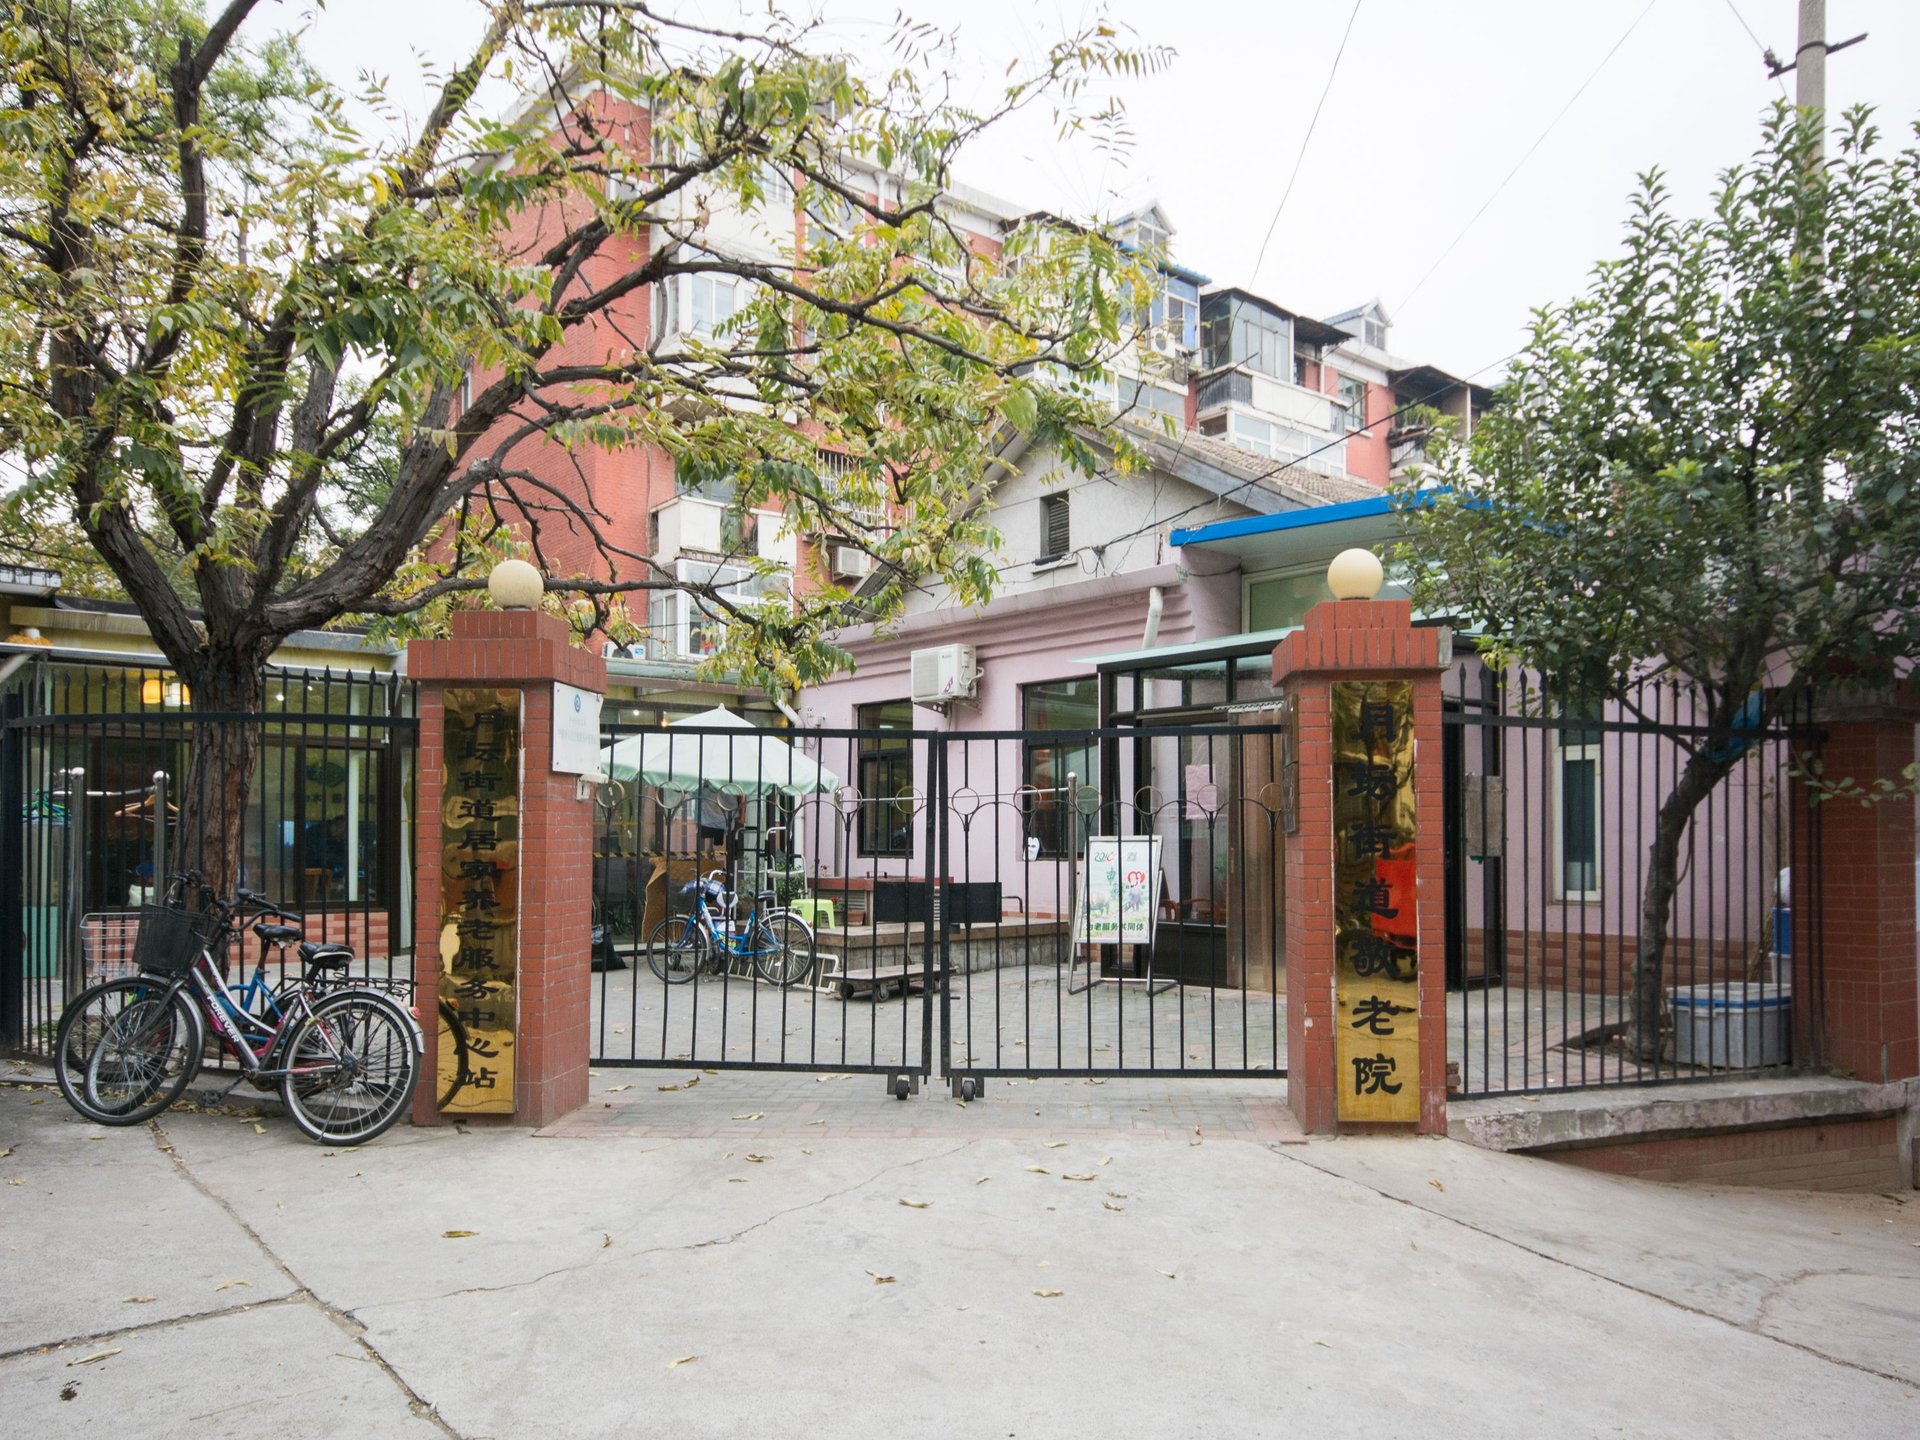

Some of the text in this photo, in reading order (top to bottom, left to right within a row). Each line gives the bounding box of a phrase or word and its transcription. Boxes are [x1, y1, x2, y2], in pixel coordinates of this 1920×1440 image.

[1348, 702, 1402, 1096] 月坛街道敬老院
[206, 995, 240, 1042] FOREVER
